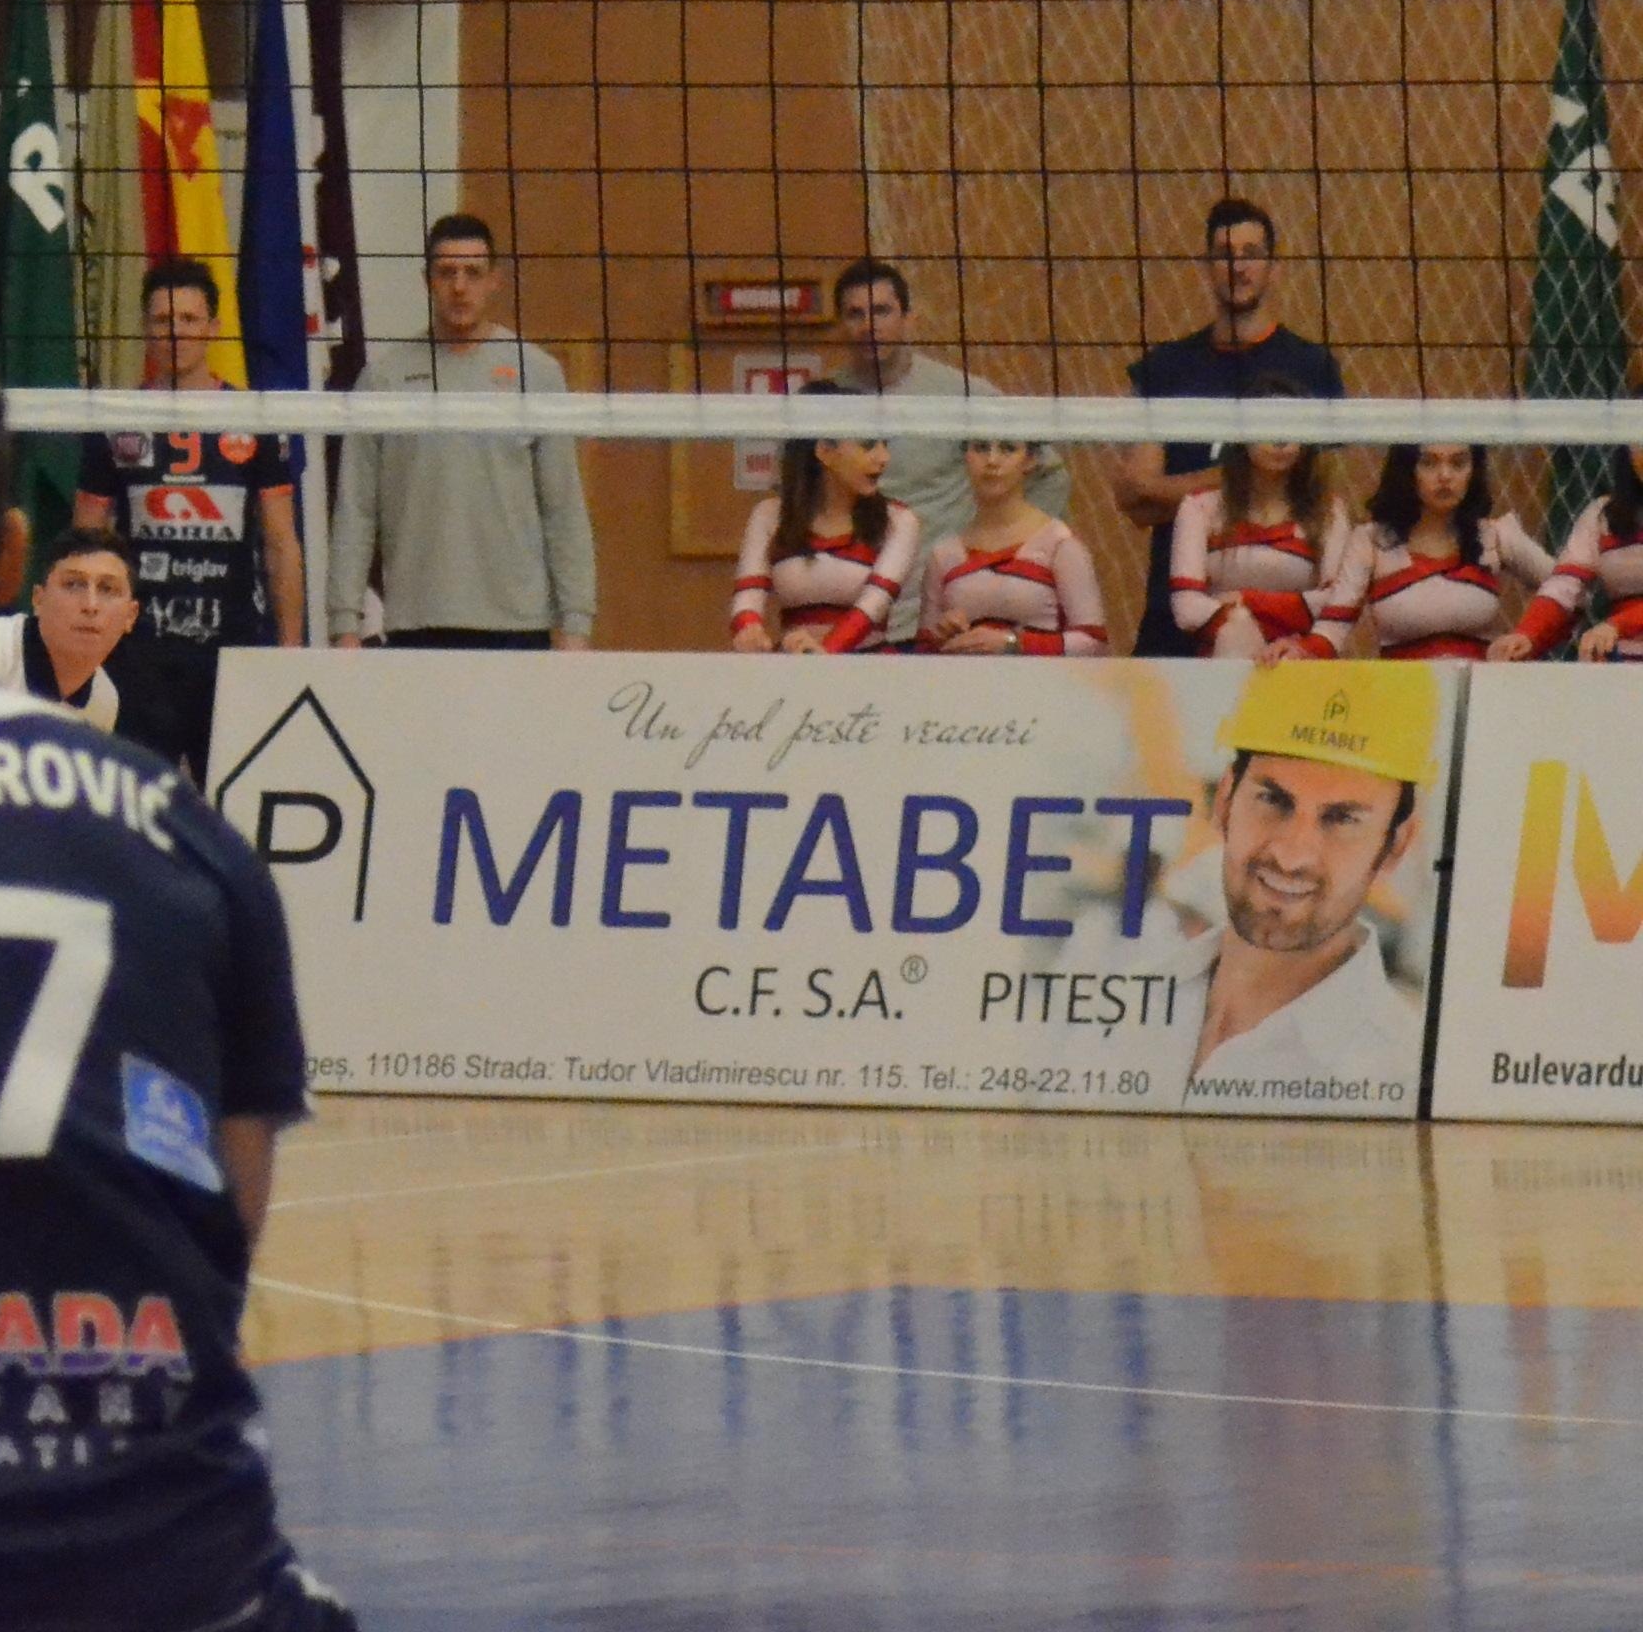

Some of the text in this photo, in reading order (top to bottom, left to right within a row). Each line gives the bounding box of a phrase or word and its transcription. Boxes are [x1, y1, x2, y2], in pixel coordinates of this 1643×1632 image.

[138, 523, 234, 540] ADRIA
[607, 680, 1039, 772] Un pod peste veacuri
[1290, 724, 1370, 751] METABET
[431, 786, 1193, 940] METABET
[694, 964, 782, 1018] C.F.
[979, 972, 1177, 1039] PITEȘTI
[366, 1051, 457, 1080] 110186
[463, 1053, 553, 1081] Strada:
[564, 1055, 636, 1084] Tudor
[644, 1057, 807, 1088] Vladimirescu
[816, 1066, 846, 1088] nr.
[979, 1066, 1151, 1096] 248-22.11.80
[1188, 1074, 1405, 1103] www.metabet.ro
[1491, 1052, 1643, 1087] Bulevardu
